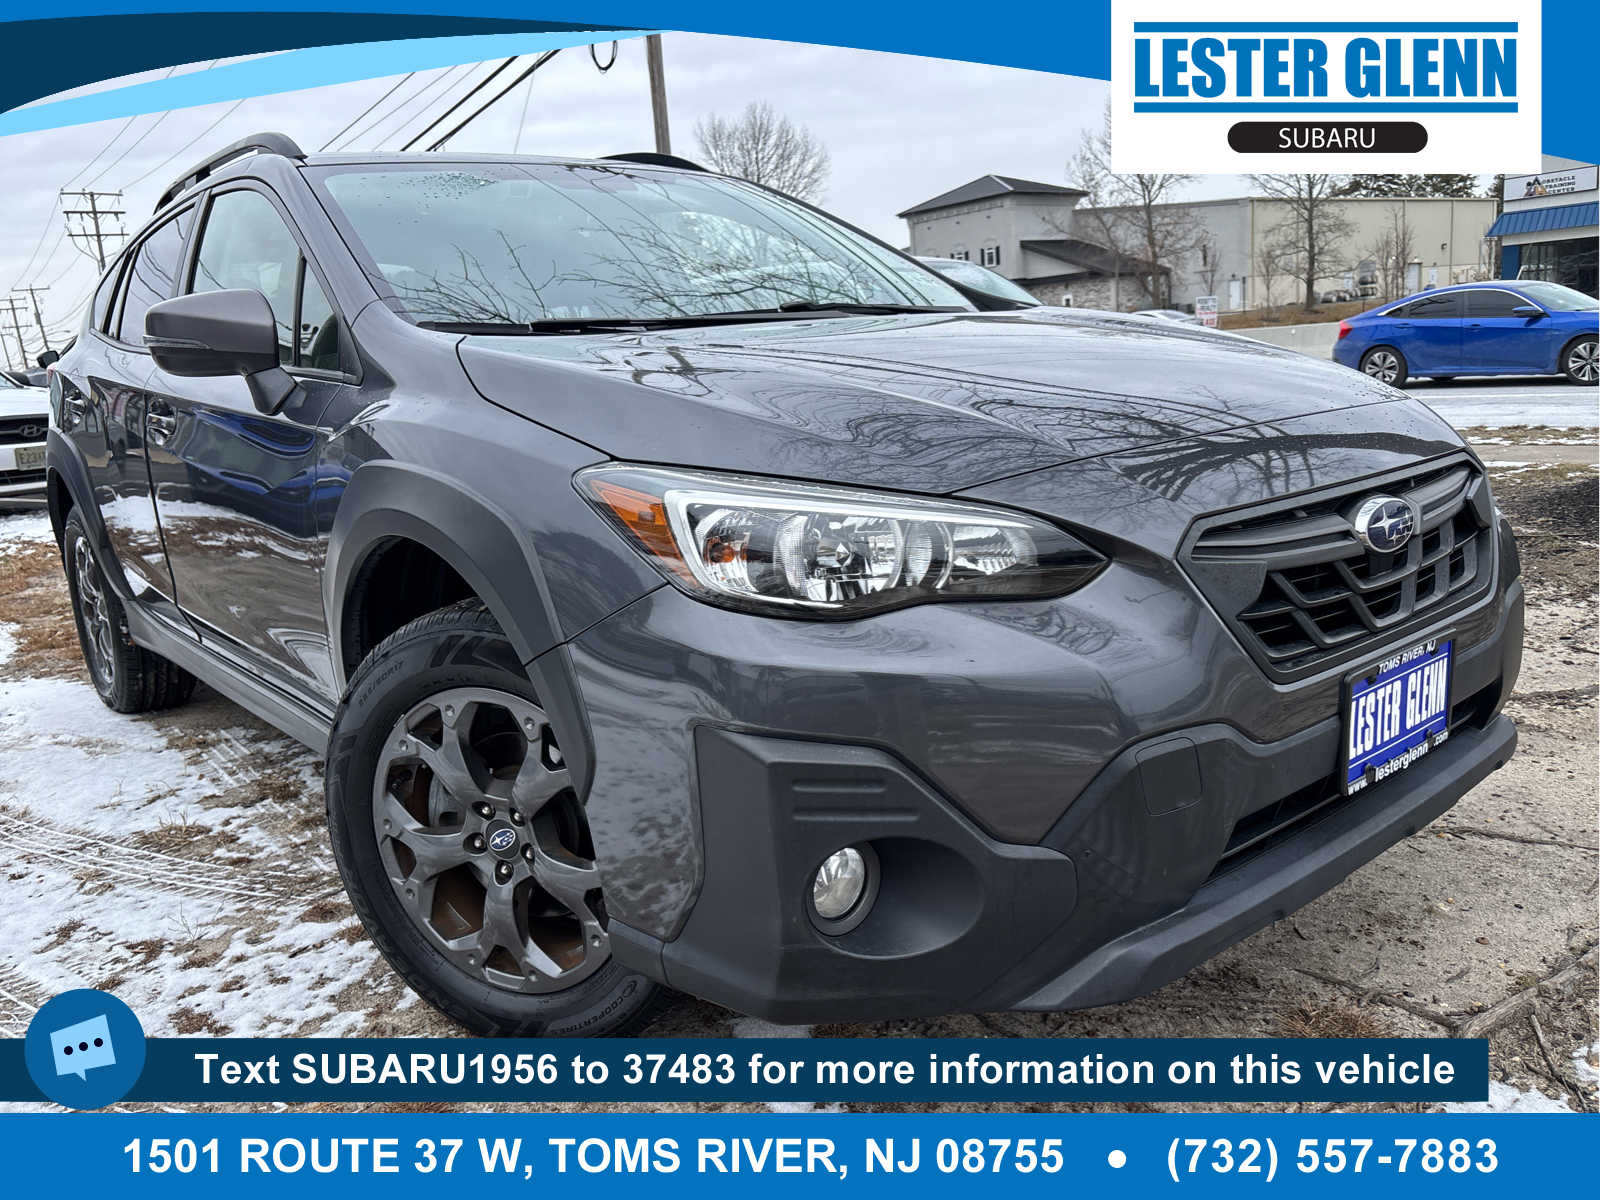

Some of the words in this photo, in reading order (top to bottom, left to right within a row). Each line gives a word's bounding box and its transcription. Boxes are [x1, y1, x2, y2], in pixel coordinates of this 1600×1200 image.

[1545, 181, 1576, 189] TRAINING
[1378, 656, 1401, 674] TOMS
[1426, 640, 1437, 655] NJ
[1349, 680, 1402, 760] LESTER
[1406, 657, 1448, 730] GLENN
